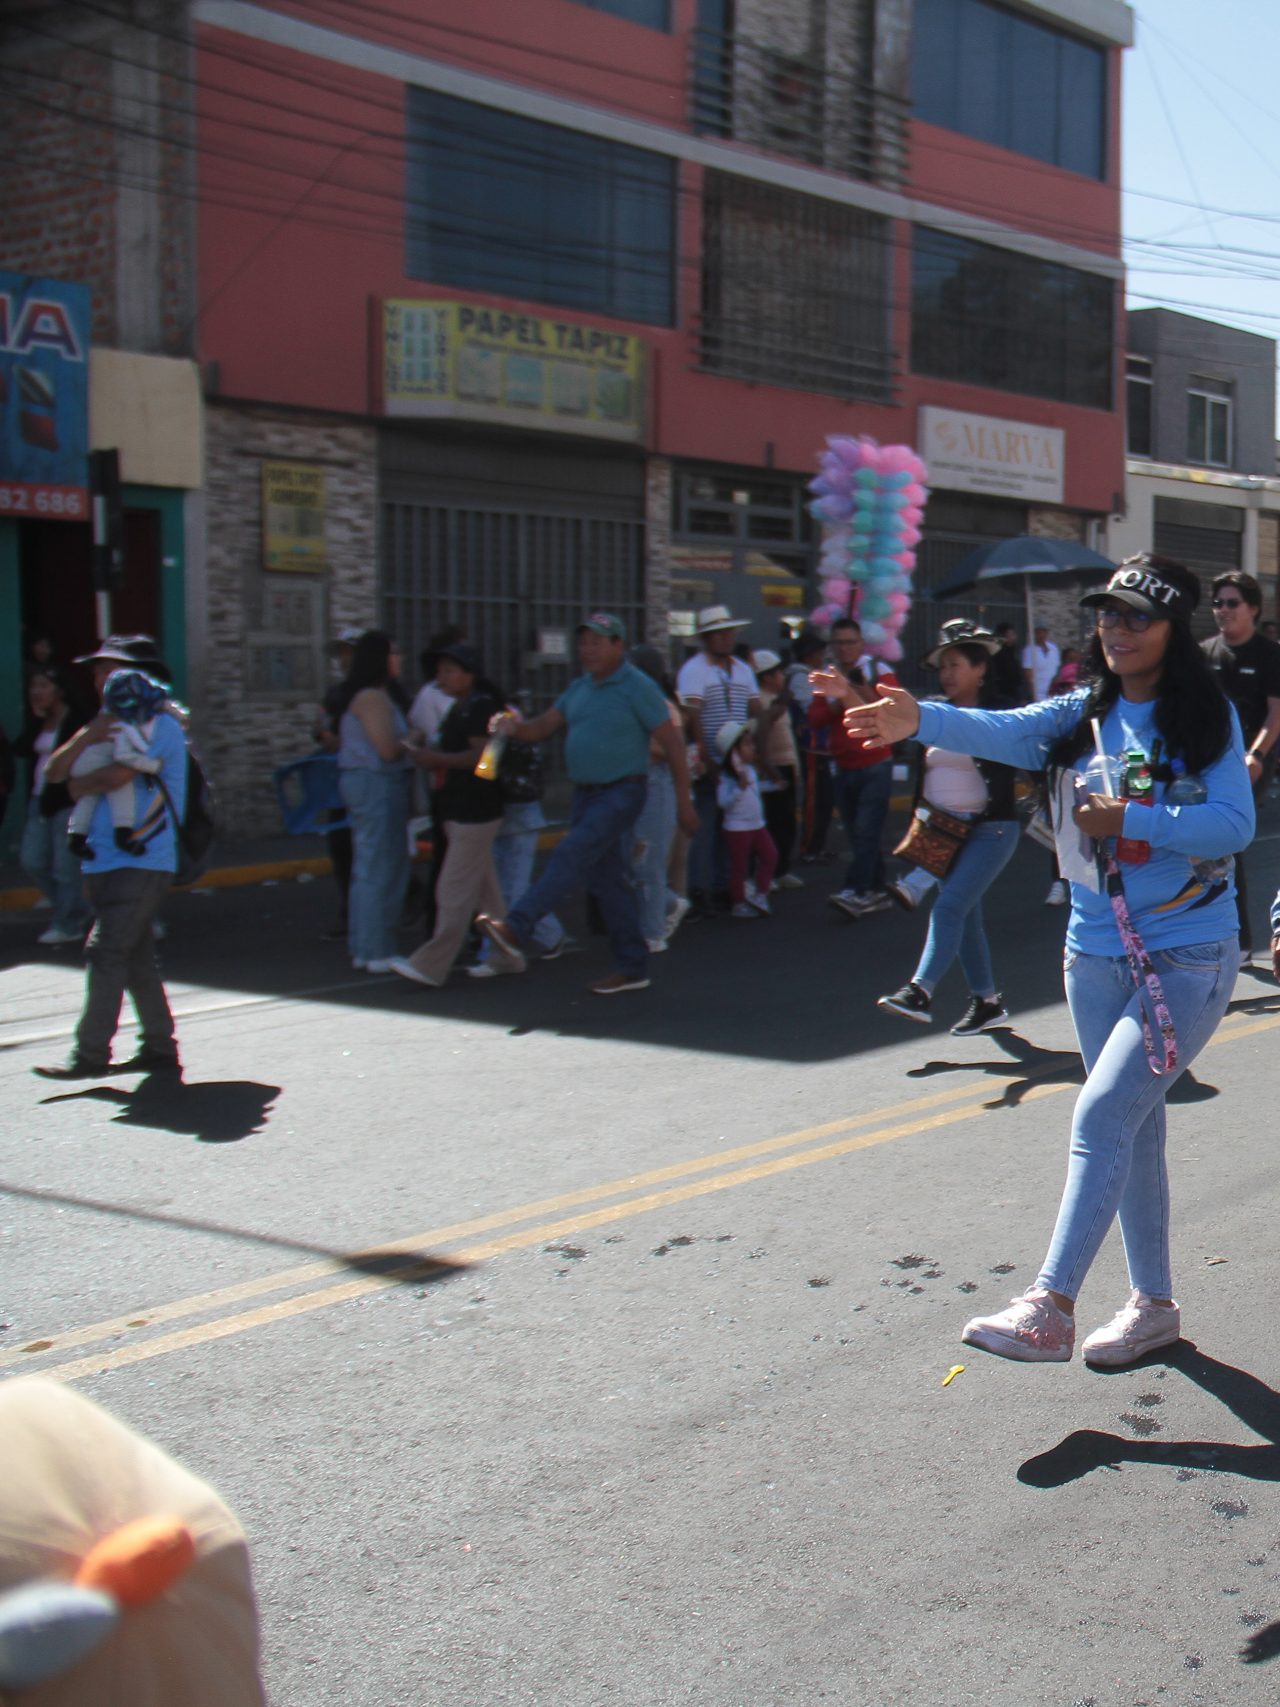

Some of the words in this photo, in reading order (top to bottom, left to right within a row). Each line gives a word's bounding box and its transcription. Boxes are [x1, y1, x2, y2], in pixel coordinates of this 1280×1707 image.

[458, 306, 547, 346] PAPEL
[554, 323, 629, 360] TAPIZ
[961, 421, 1057, 470] MARVA
[34, 490, 82, 515] 686
